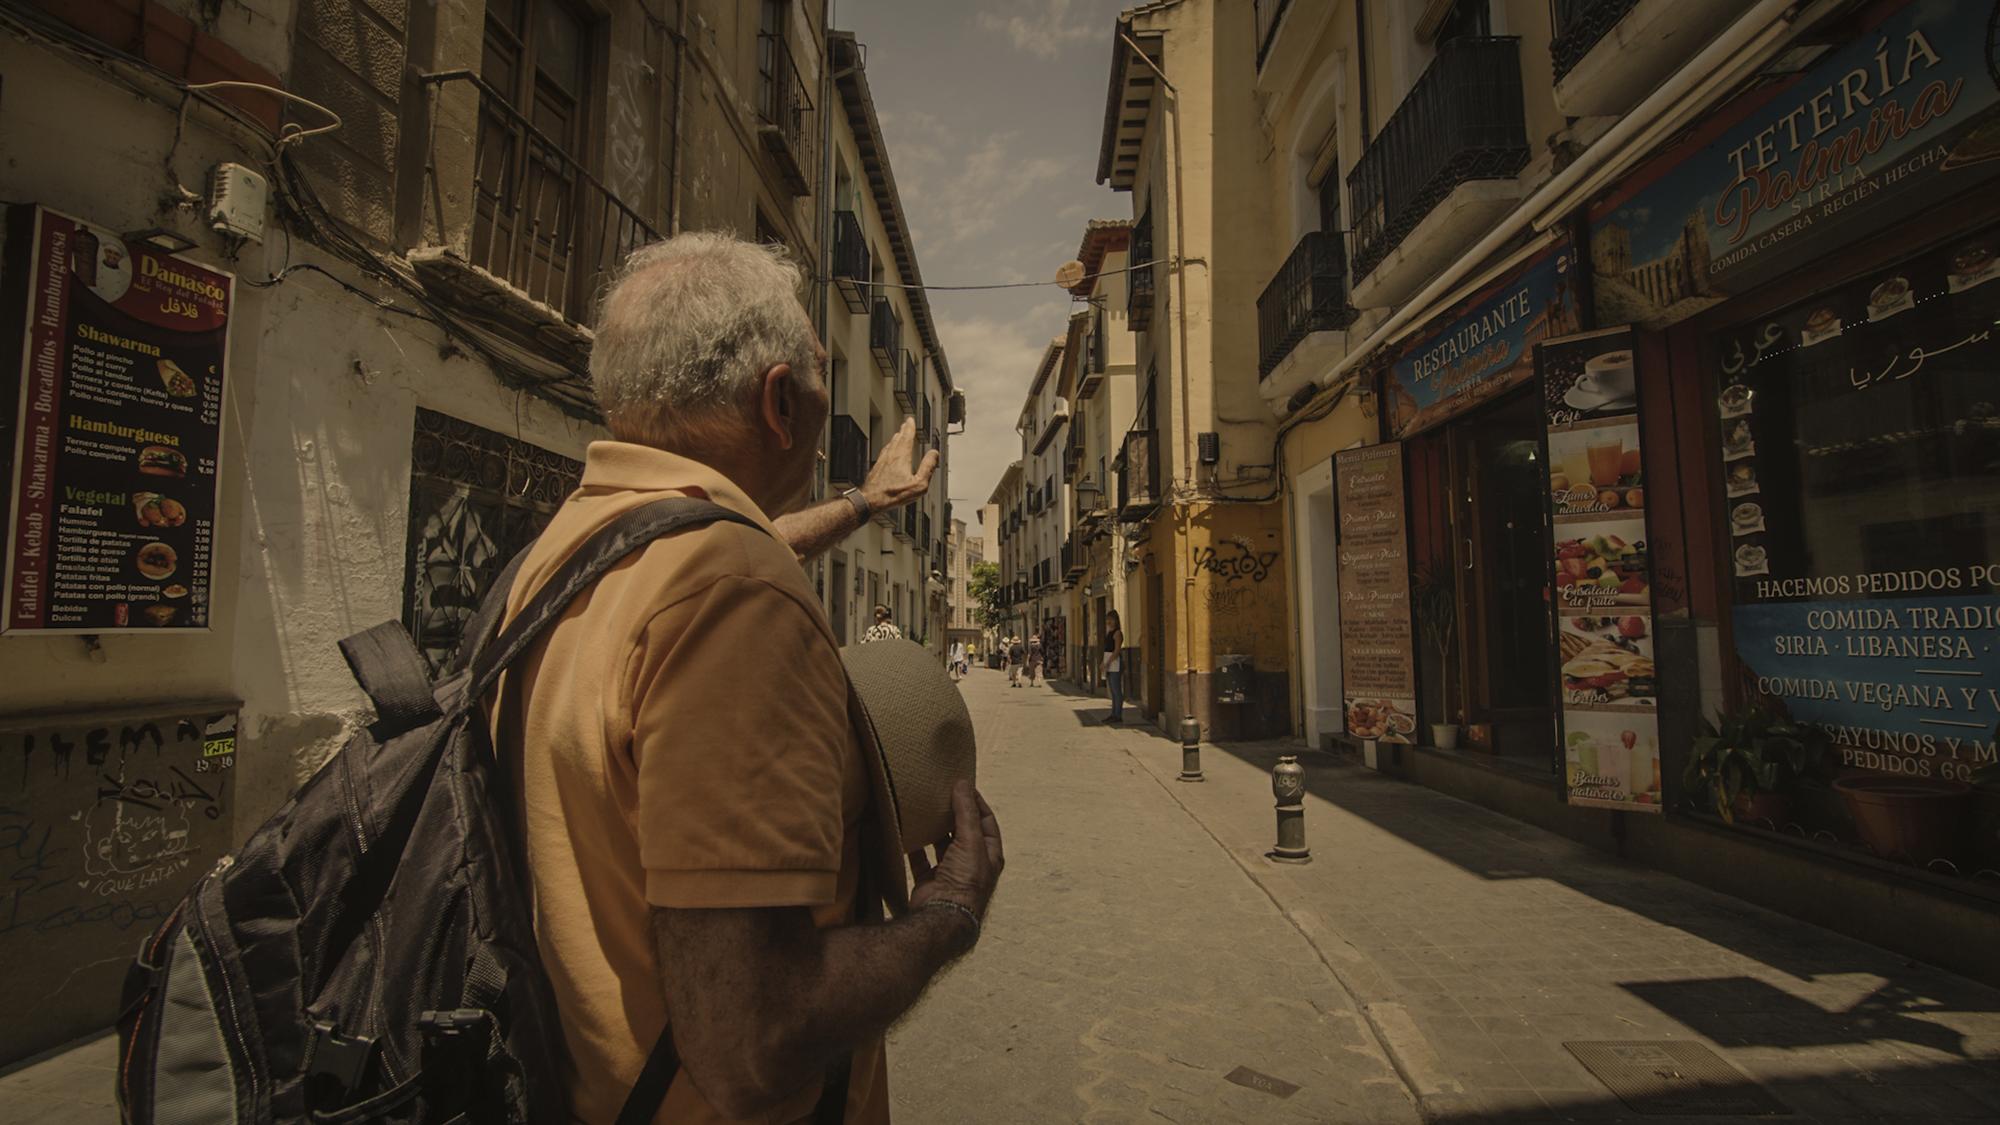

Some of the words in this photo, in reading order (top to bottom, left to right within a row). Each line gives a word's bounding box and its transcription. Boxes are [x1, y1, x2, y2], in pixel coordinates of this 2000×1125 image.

[1727, 29, 1942, 185] TETERÍA
[1715, 77, 1964, 245] Palmira
[1709, 244, 1758, 275] COMIDA
[1758, 215, 1813, 249] CASERA
[1822, 175, 1880, 218] RECIÉN
[1884, 144, 1950, 186] HECHA
[1790, 166, 1867, 217] SIRIA
[41, 231, 68, 328] Hamburguesa
[140, 254, 225, 301] Damasco
[77, 323, 161, 357] Shawarma
[1413, 288, 1531, 383] RESTAURANTE
[33, 340, 57, 413] Bocadillos
[1850, 329, 1991, 391] سوريا
[69, 414, 180, 446] Hamburguesa
[27, 425, 50, 499] Shawarma
[60, 504, 103, 517] Falafel
[65, 486, 127, 505] Vegetal
[23, 511, 43, 558] Kebab
[18, 569, 39, 620] Falafel
[1757, 575, 1850, 598] HACEMOS
[1856, 567, 1962, 594] PEDIDOS
[1807, 608, 1900, 631] COMIDA
[1775, 635, 1829, 656] SIRIA
[1846, 635, 1976, 659] LIBANESA
[1757, 676, 1840, 701] COMIDA
[1845, 680, 1953, 713] VEGANA
[1959, 687, 1980, 711] Y
[1842, 749, 1932, 778] PEDIDOS
[1943, 736, 1962, 760] Y
